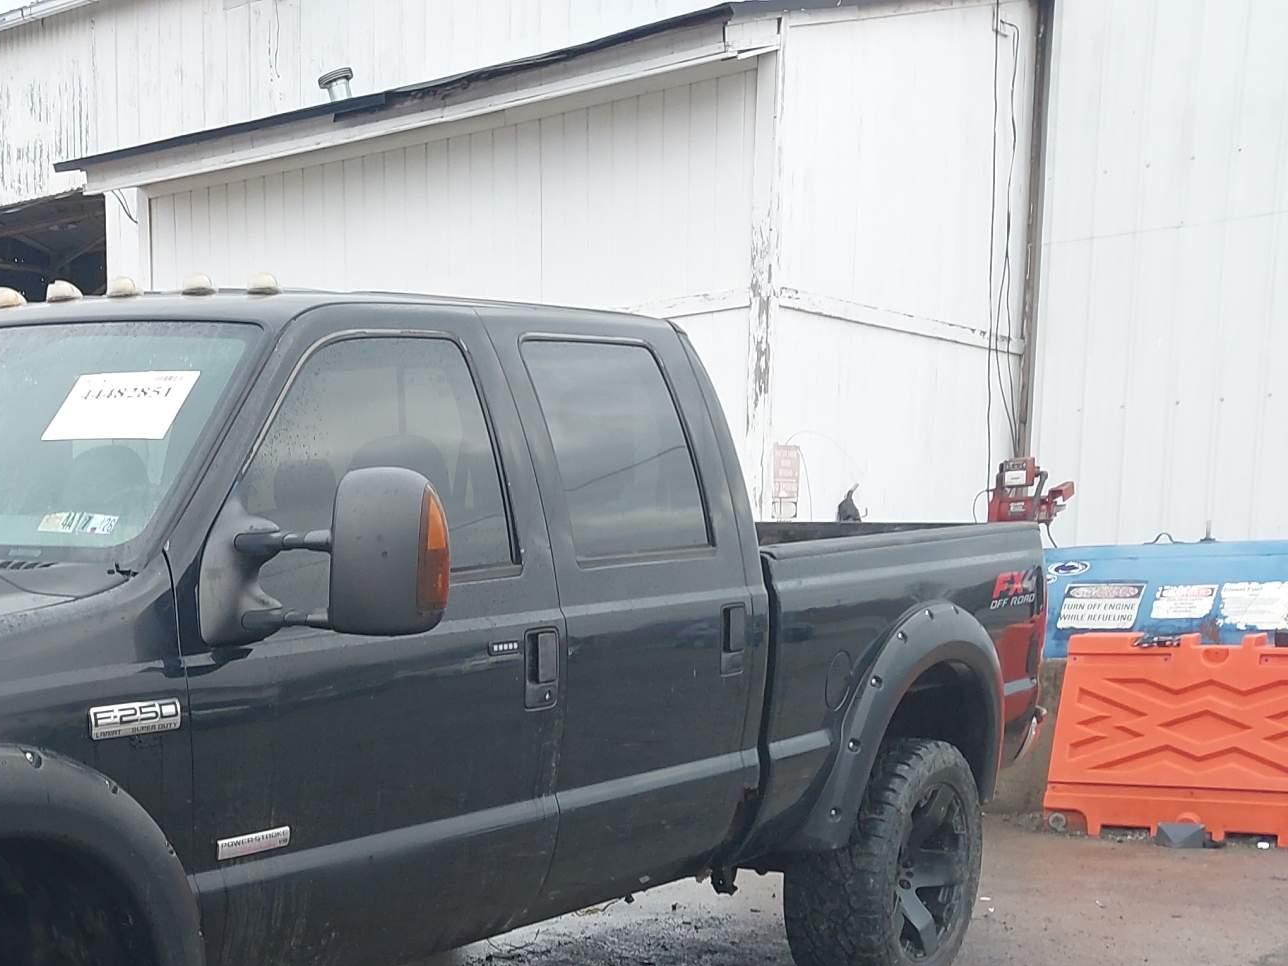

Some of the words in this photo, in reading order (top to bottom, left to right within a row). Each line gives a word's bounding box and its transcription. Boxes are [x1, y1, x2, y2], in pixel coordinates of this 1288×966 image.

[992, 569, 1037, 599] FX4
[990, 598, 1008, 609] OFF
[1010, 593, 1035, 607] ROAD
[1063, 602, 1085, 610] TURN
[1087, 602, 1101, 610] OFF
[1103, 602, 1136, 610] ENGINE
[93, 701, 179, 728] F-250
